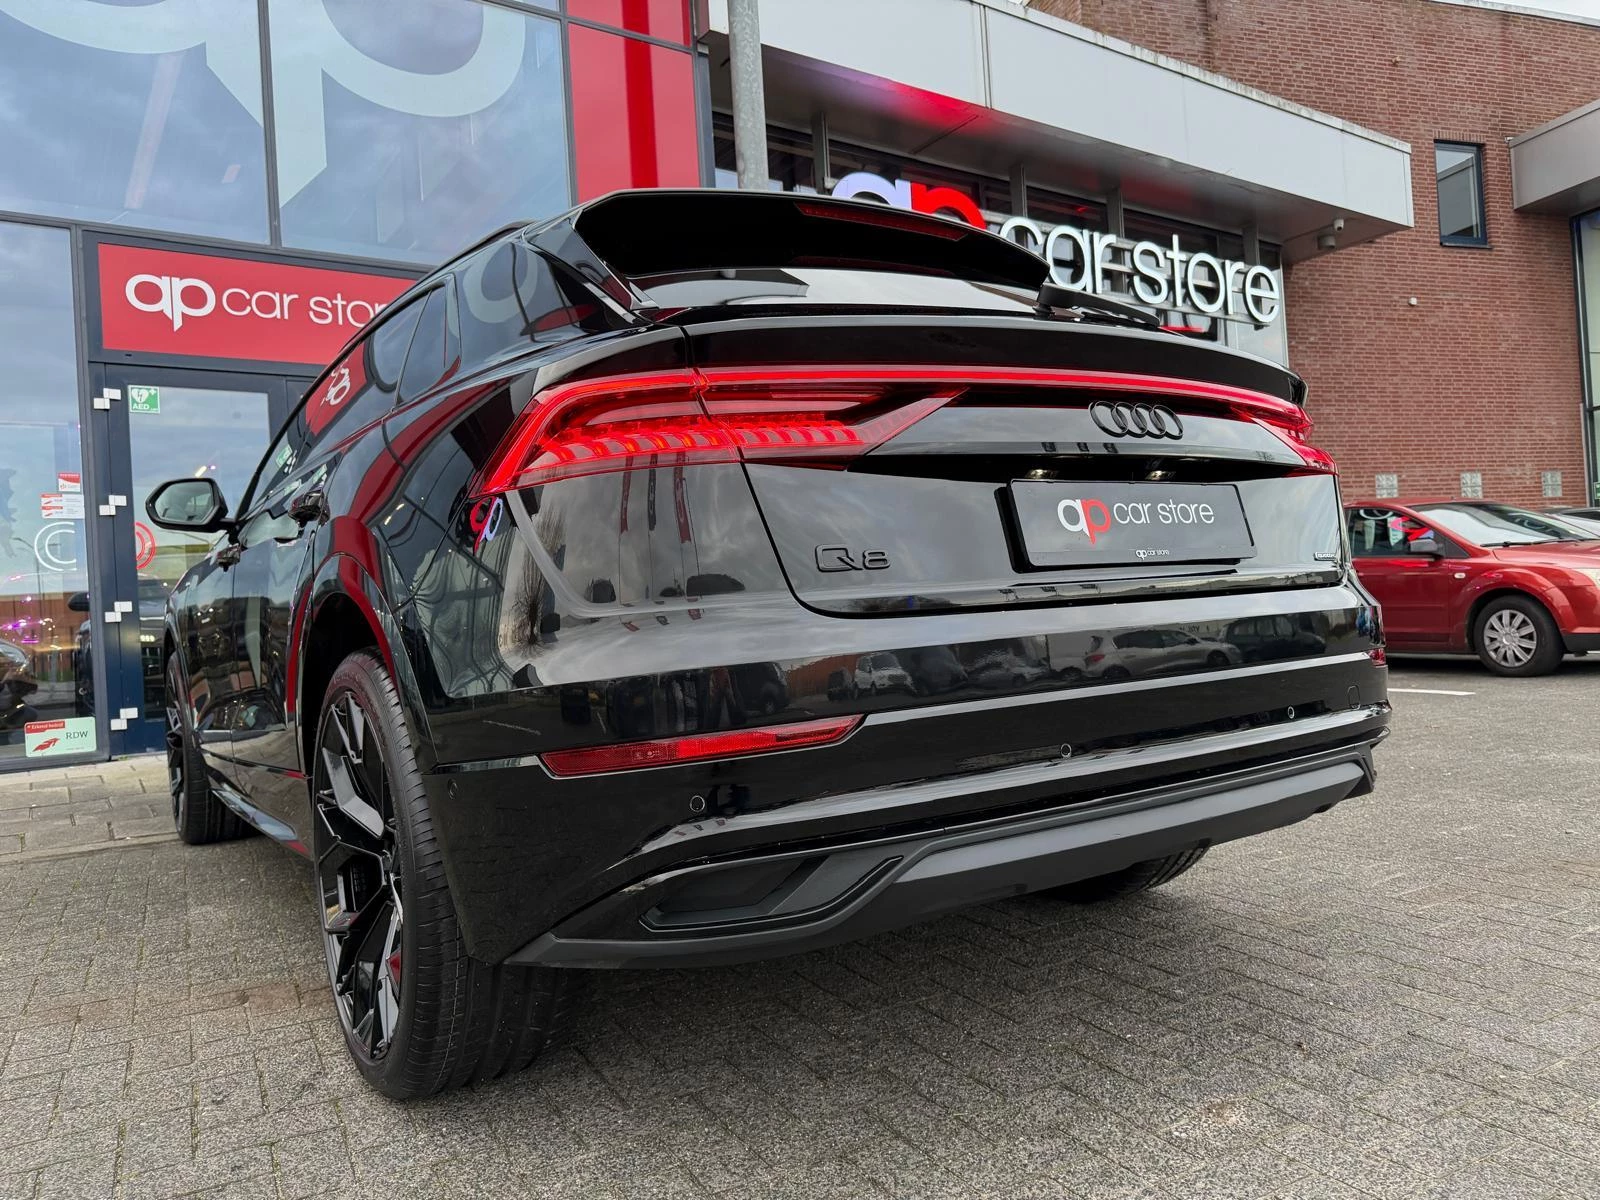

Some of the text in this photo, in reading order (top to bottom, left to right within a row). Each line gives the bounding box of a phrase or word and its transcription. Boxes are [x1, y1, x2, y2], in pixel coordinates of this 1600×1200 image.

[125, 273, 216, 332] ap
[222, 287, 299, 320] car
[1132, 234, 1280, 324] store
[1057, 498, 1215, 545] ap car store
[815, 544, 891, 573] Q8
[65, 730, 88, 740] RDW
